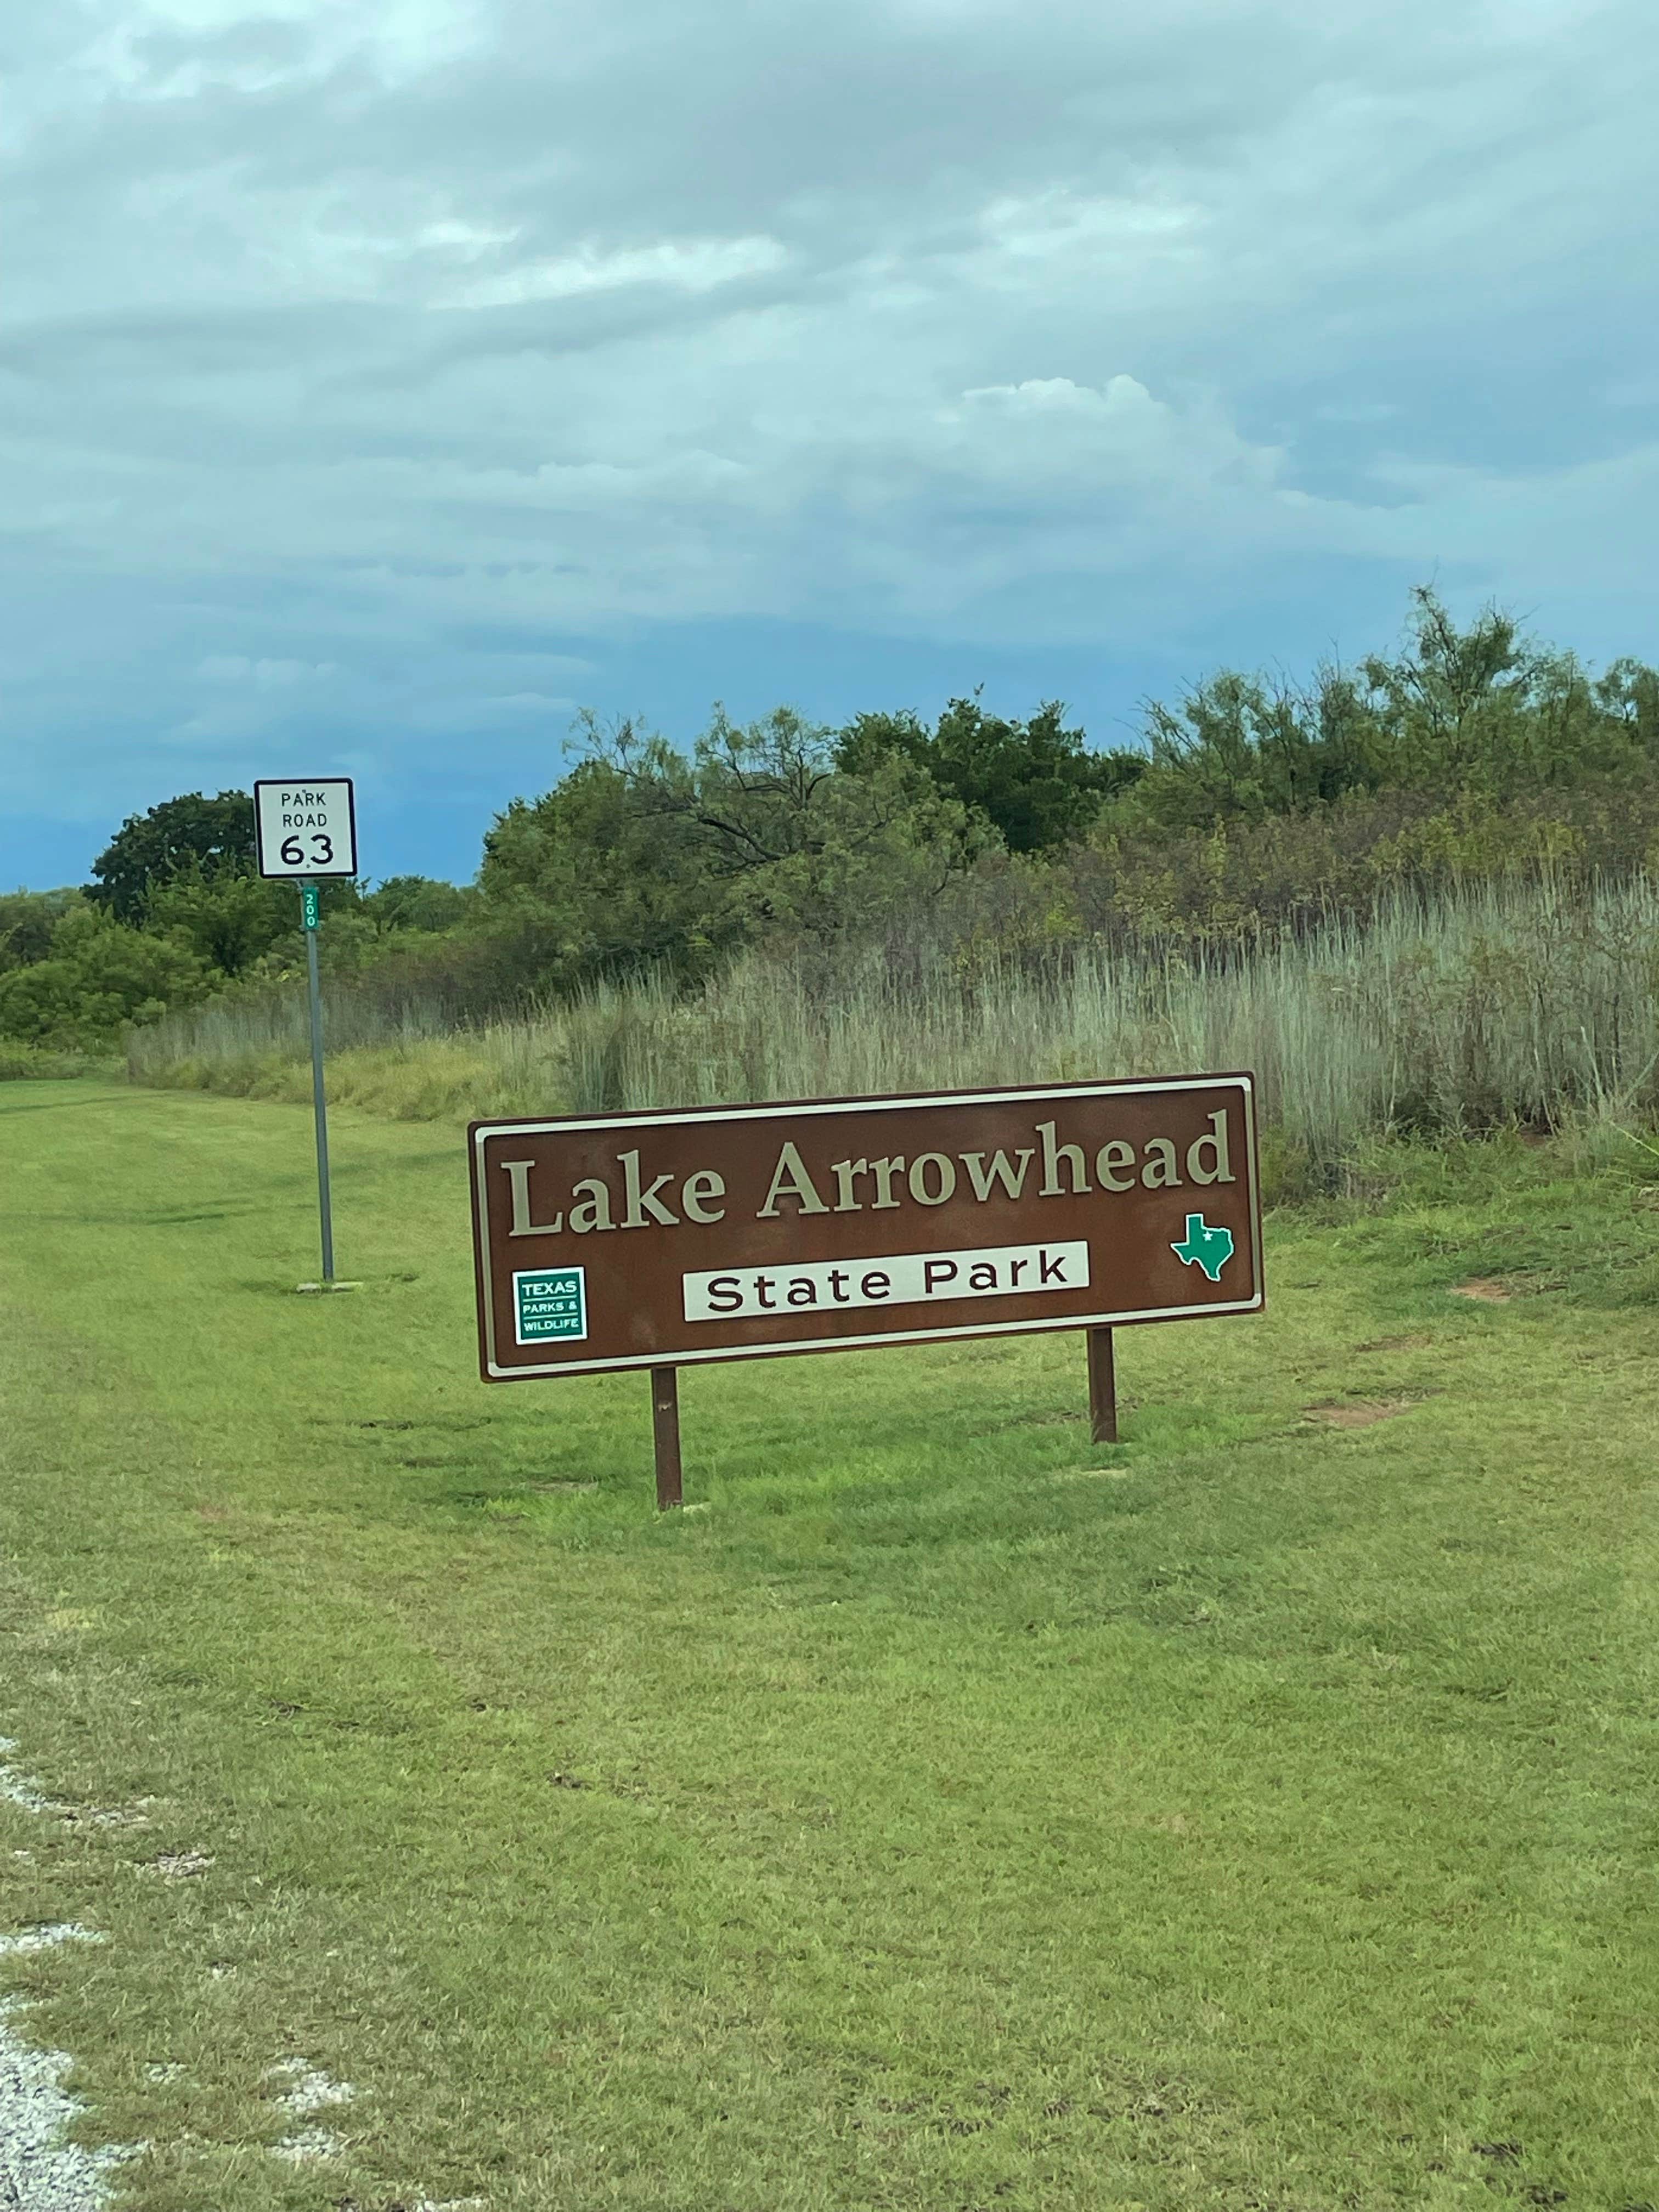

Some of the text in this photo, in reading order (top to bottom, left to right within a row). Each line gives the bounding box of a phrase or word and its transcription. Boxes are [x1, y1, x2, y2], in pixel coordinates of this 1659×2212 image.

[281, 793, 326, 806] PARK
[283, 814, 327, 827] ROAD
[280, 834, 334, 865] 63
[306, 894, 315, 927] 200
[500, 1109, 1236, 1237] Lake Arrowhead
[522, 1280, 577, 1296] TEXAS
[707, 1250, 1068, 1312] State Park
[523, 1301, 577, 1313] PARKS &
[524, 1318, 579, 1331] WILDLIFE
